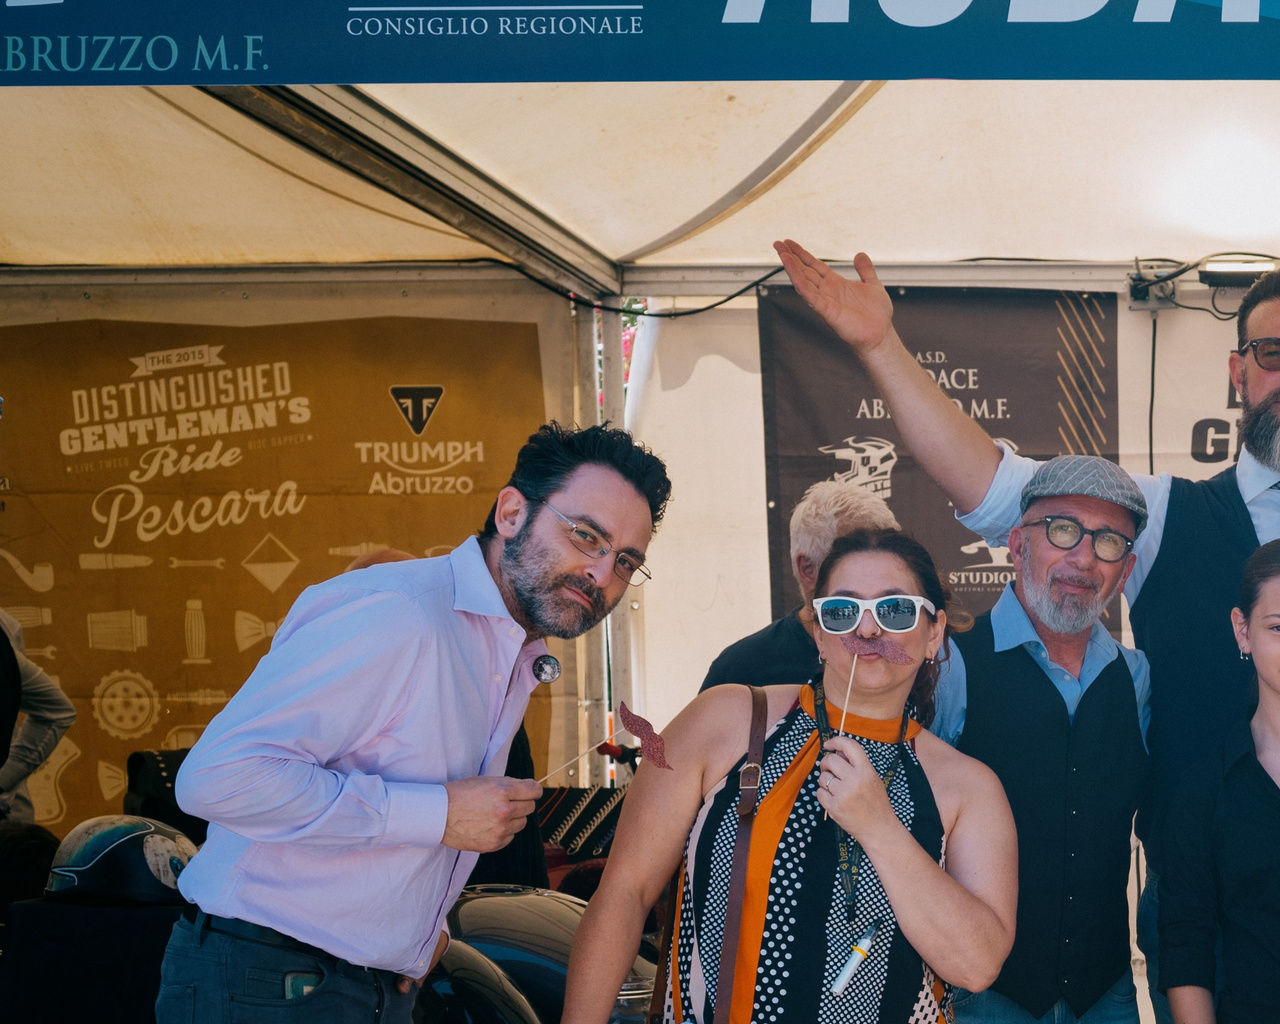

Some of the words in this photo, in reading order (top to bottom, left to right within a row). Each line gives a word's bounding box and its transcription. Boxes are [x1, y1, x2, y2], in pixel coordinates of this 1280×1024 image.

[346, 17, 489, 36] CONSIGLIO
[498, 16, 644, 35] REGIONALE
[0, 35, 179, 72] BRUZZO
[191, 34, 270, 72] M.F.
[149, 353, 174, 367] THE
[175, 350, 205, 364] 2015
[72, 361, 291, 425] DISTINGUISHED
[59, 396, 311, 456] GENTLEMAN'S
[129, 439, 243, 483] Ride
[354, 441, 485, 473] TRIUMPH
[368, 472, 474, 495] Abruzzo
[91, 480, 306, 549] Pescara
